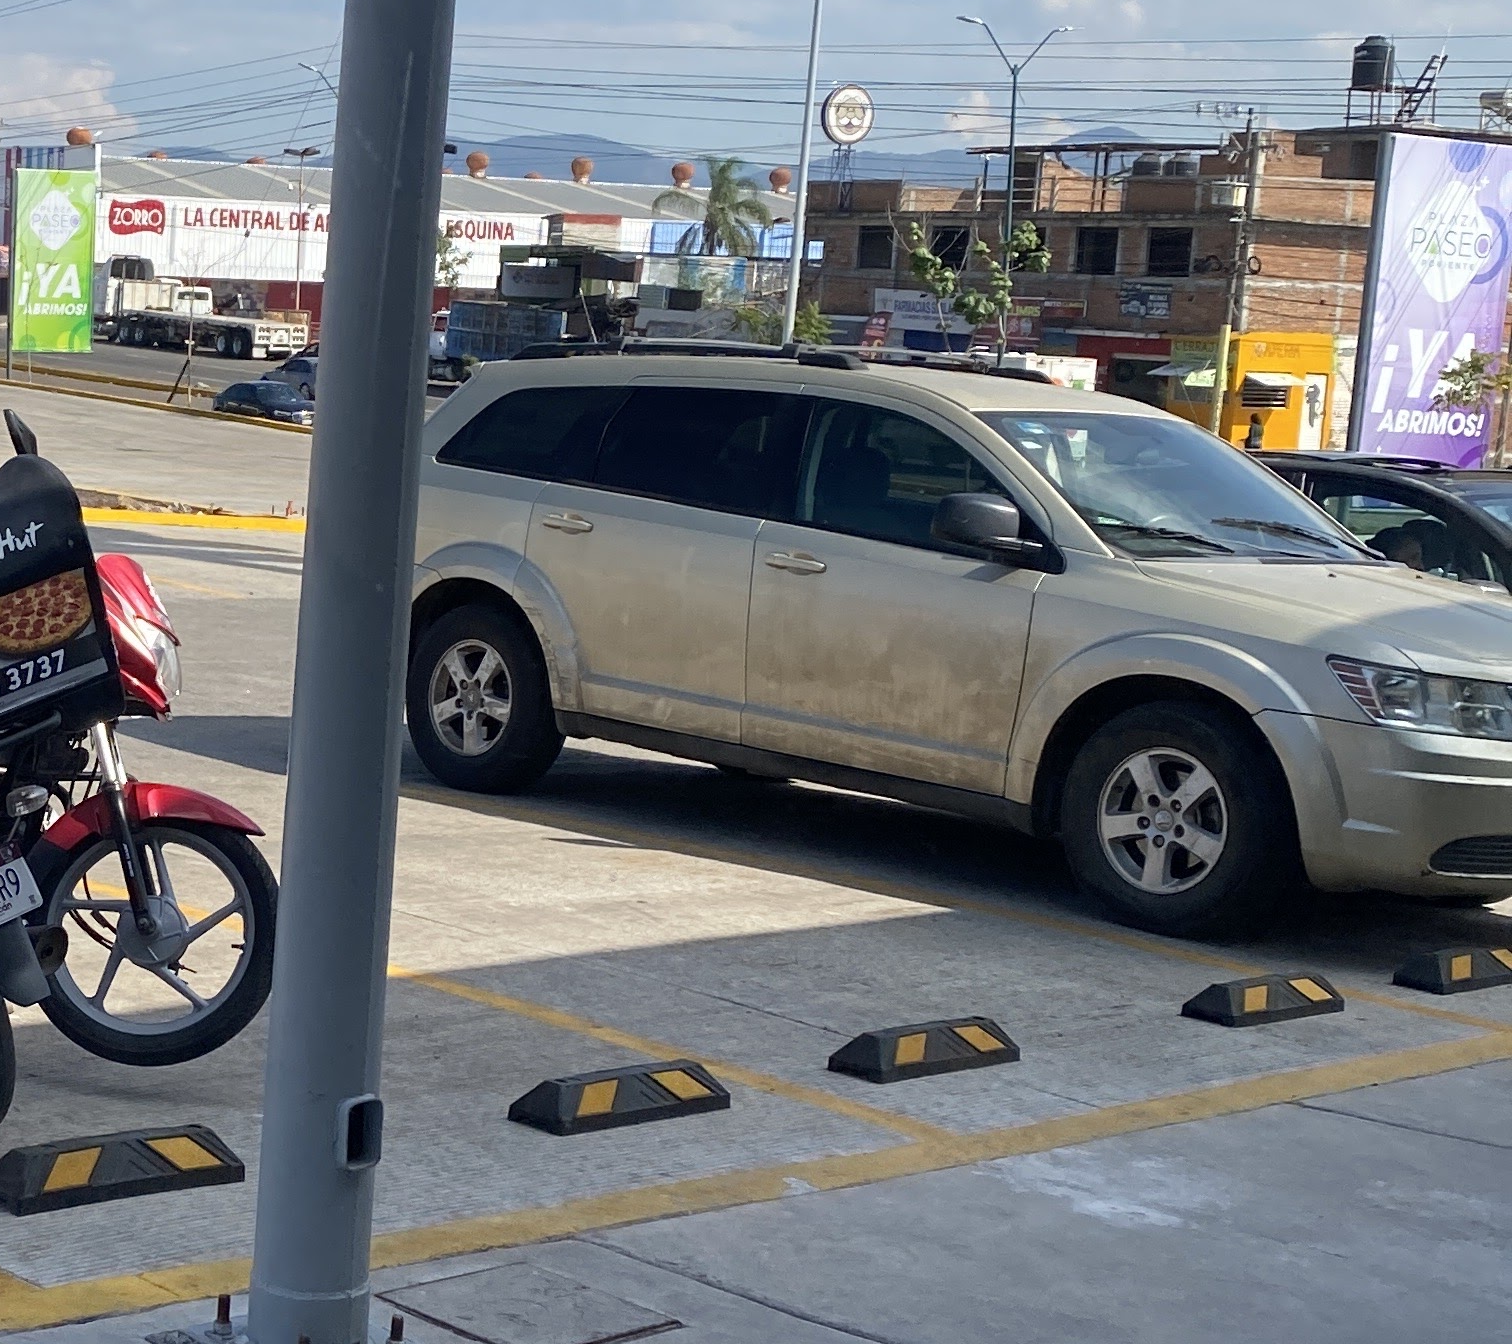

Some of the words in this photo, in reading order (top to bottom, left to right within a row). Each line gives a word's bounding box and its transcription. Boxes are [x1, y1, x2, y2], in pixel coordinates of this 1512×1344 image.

[31, 213, 81, 229] PASEO
[112, 207, 163, 227] ZORRO
[183, 206, 204, 227] LA
[209, 207, 285, 231] CENTRAL
[289, 212, 311, 231] DE
[445, 219, 515, 242] ESQUINA
[1428, 211, 1479, 229] PLAZA
[1410, 227, 1492, 259] PASEO
[18, 262, 82, 306] ¡YA
[23, 302, 88, 316] ABRIMOS!
[1376, 409, 1485, 438] ABRIMOS!
[6, 649, 65, 691] 3737
